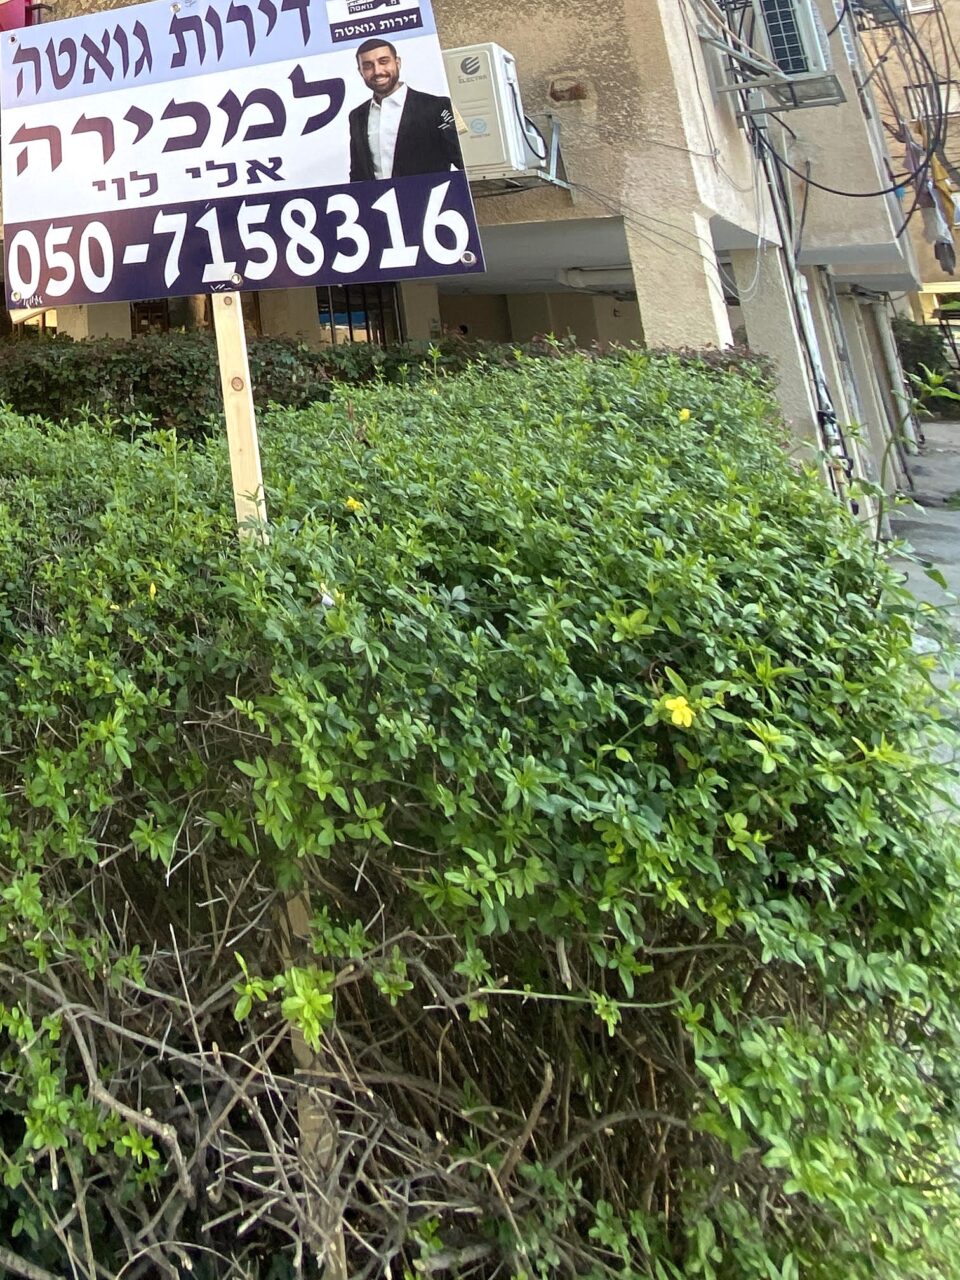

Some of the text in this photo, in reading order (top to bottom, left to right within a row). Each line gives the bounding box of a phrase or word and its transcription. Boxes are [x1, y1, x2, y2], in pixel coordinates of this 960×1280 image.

[12, 19, 153, 98] גואטה
[334, 14, 417, 38] דירות גואטה
[8, 63, 346, 177] למכירה
[92, 156, 285, 201] אלי לוי
[8, 180, 470, 300] 050-7158316
